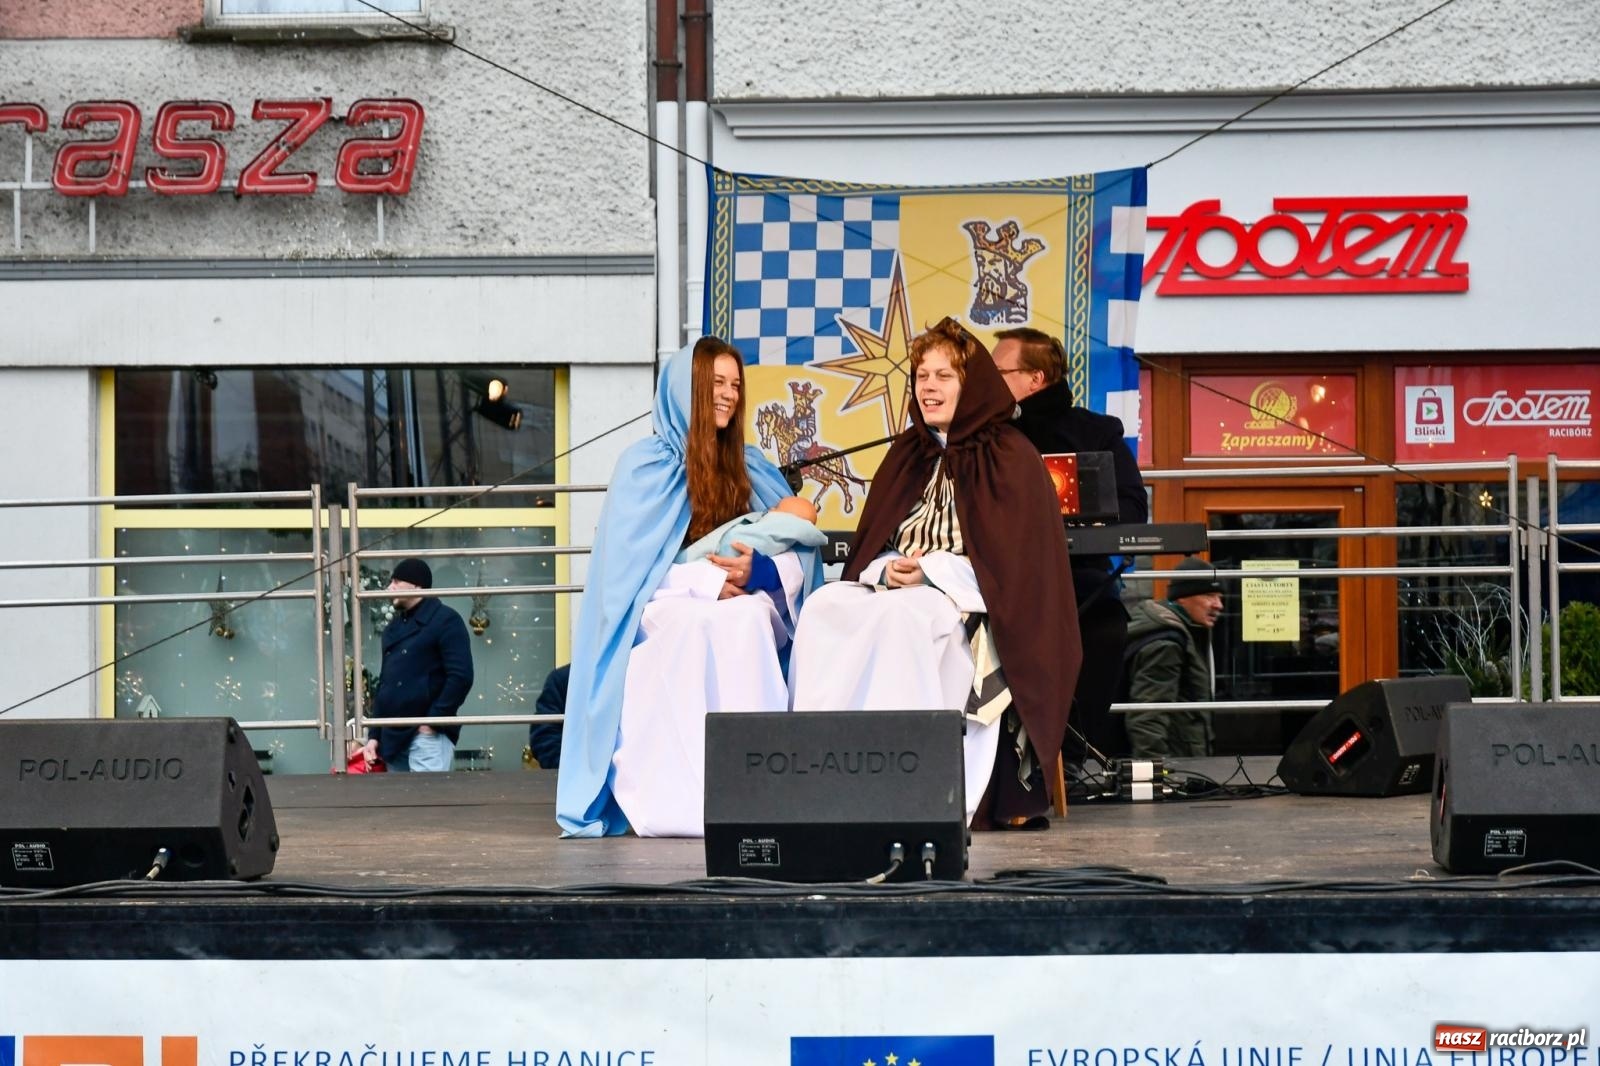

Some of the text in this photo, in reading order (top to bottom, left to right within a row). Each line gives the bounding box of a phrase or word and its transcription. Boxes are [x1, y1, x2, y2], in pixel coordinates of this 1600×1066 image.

[1221, 433, 1316, 450] Zapraszamy
[1549, 427, 1592, 437] RACIBÓRZ
[19, 758, 183, 782] POL-AUDIO
[747, 751, 919, 775] POL-AUDIO
